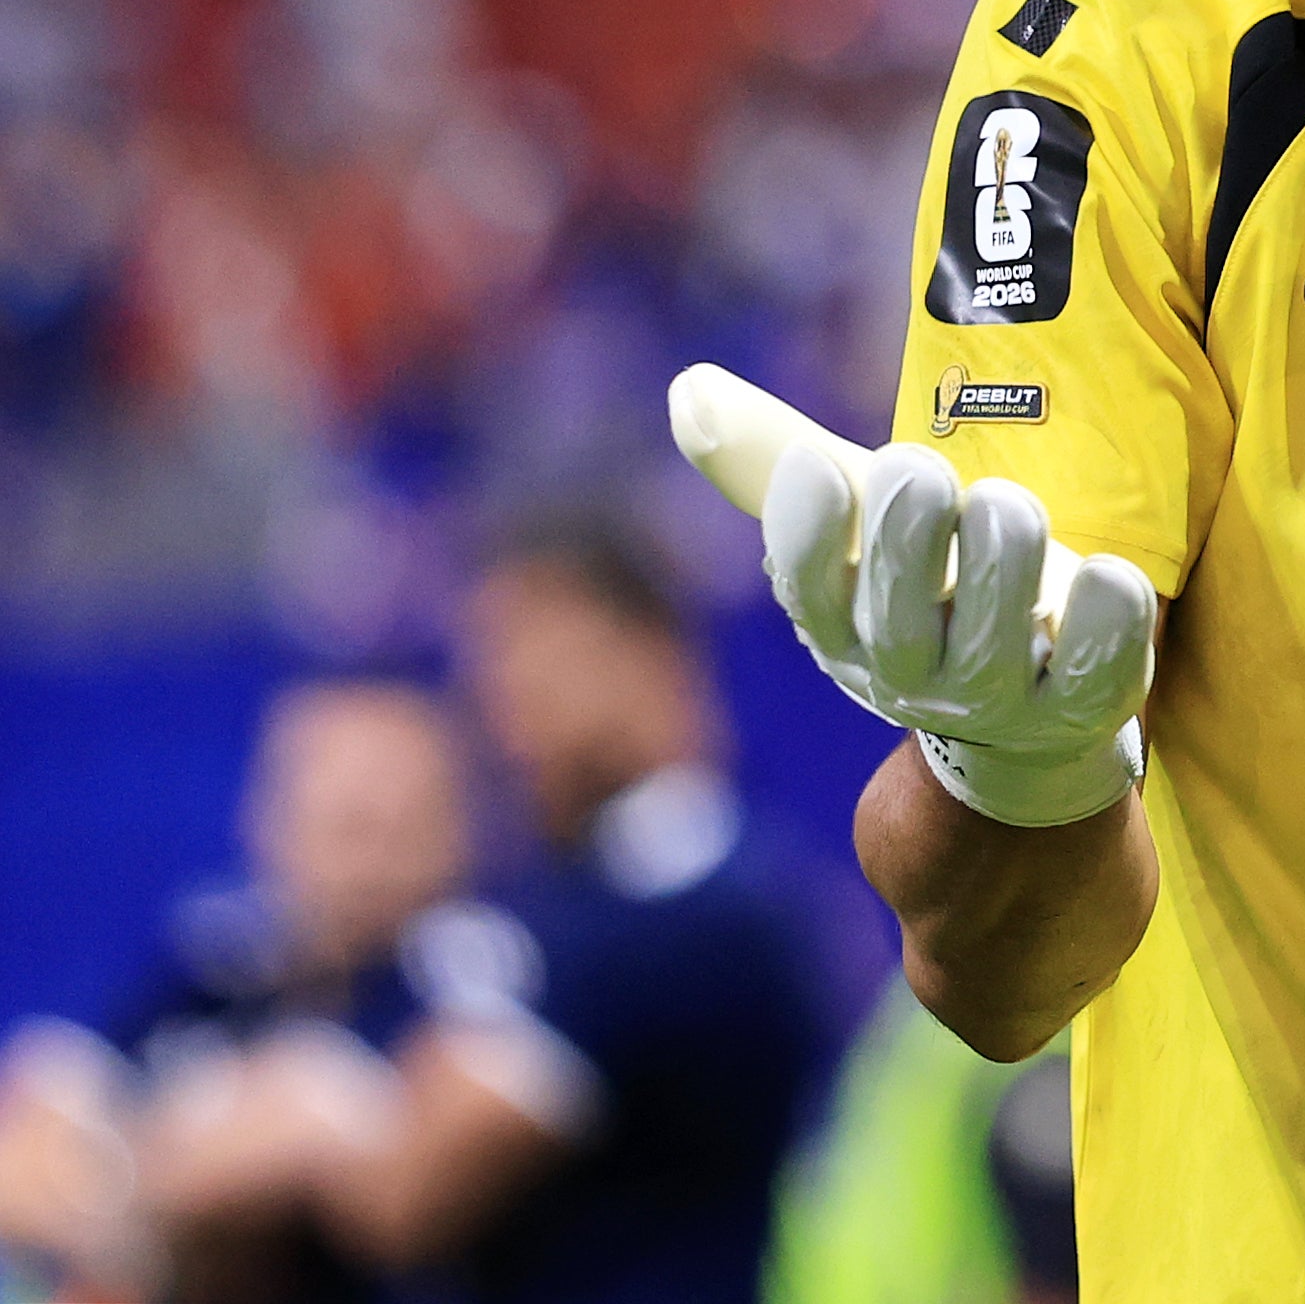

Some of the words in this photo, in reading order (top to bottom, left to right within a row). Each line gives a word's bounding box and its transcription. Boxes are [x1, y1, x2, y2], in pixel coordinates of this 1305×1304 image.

[992, 230, 1015, 247] FIFA
[976, 265, 1012, 284] WORLD
[1012, 263, 1033, 281] CUP
[971, 280, 1036, 308] 2026
[960, 388, 1038, 404] DEBUT
[980, 404, 1012, 414] WORLD
[1012, 404, 1031, 414] CUP
